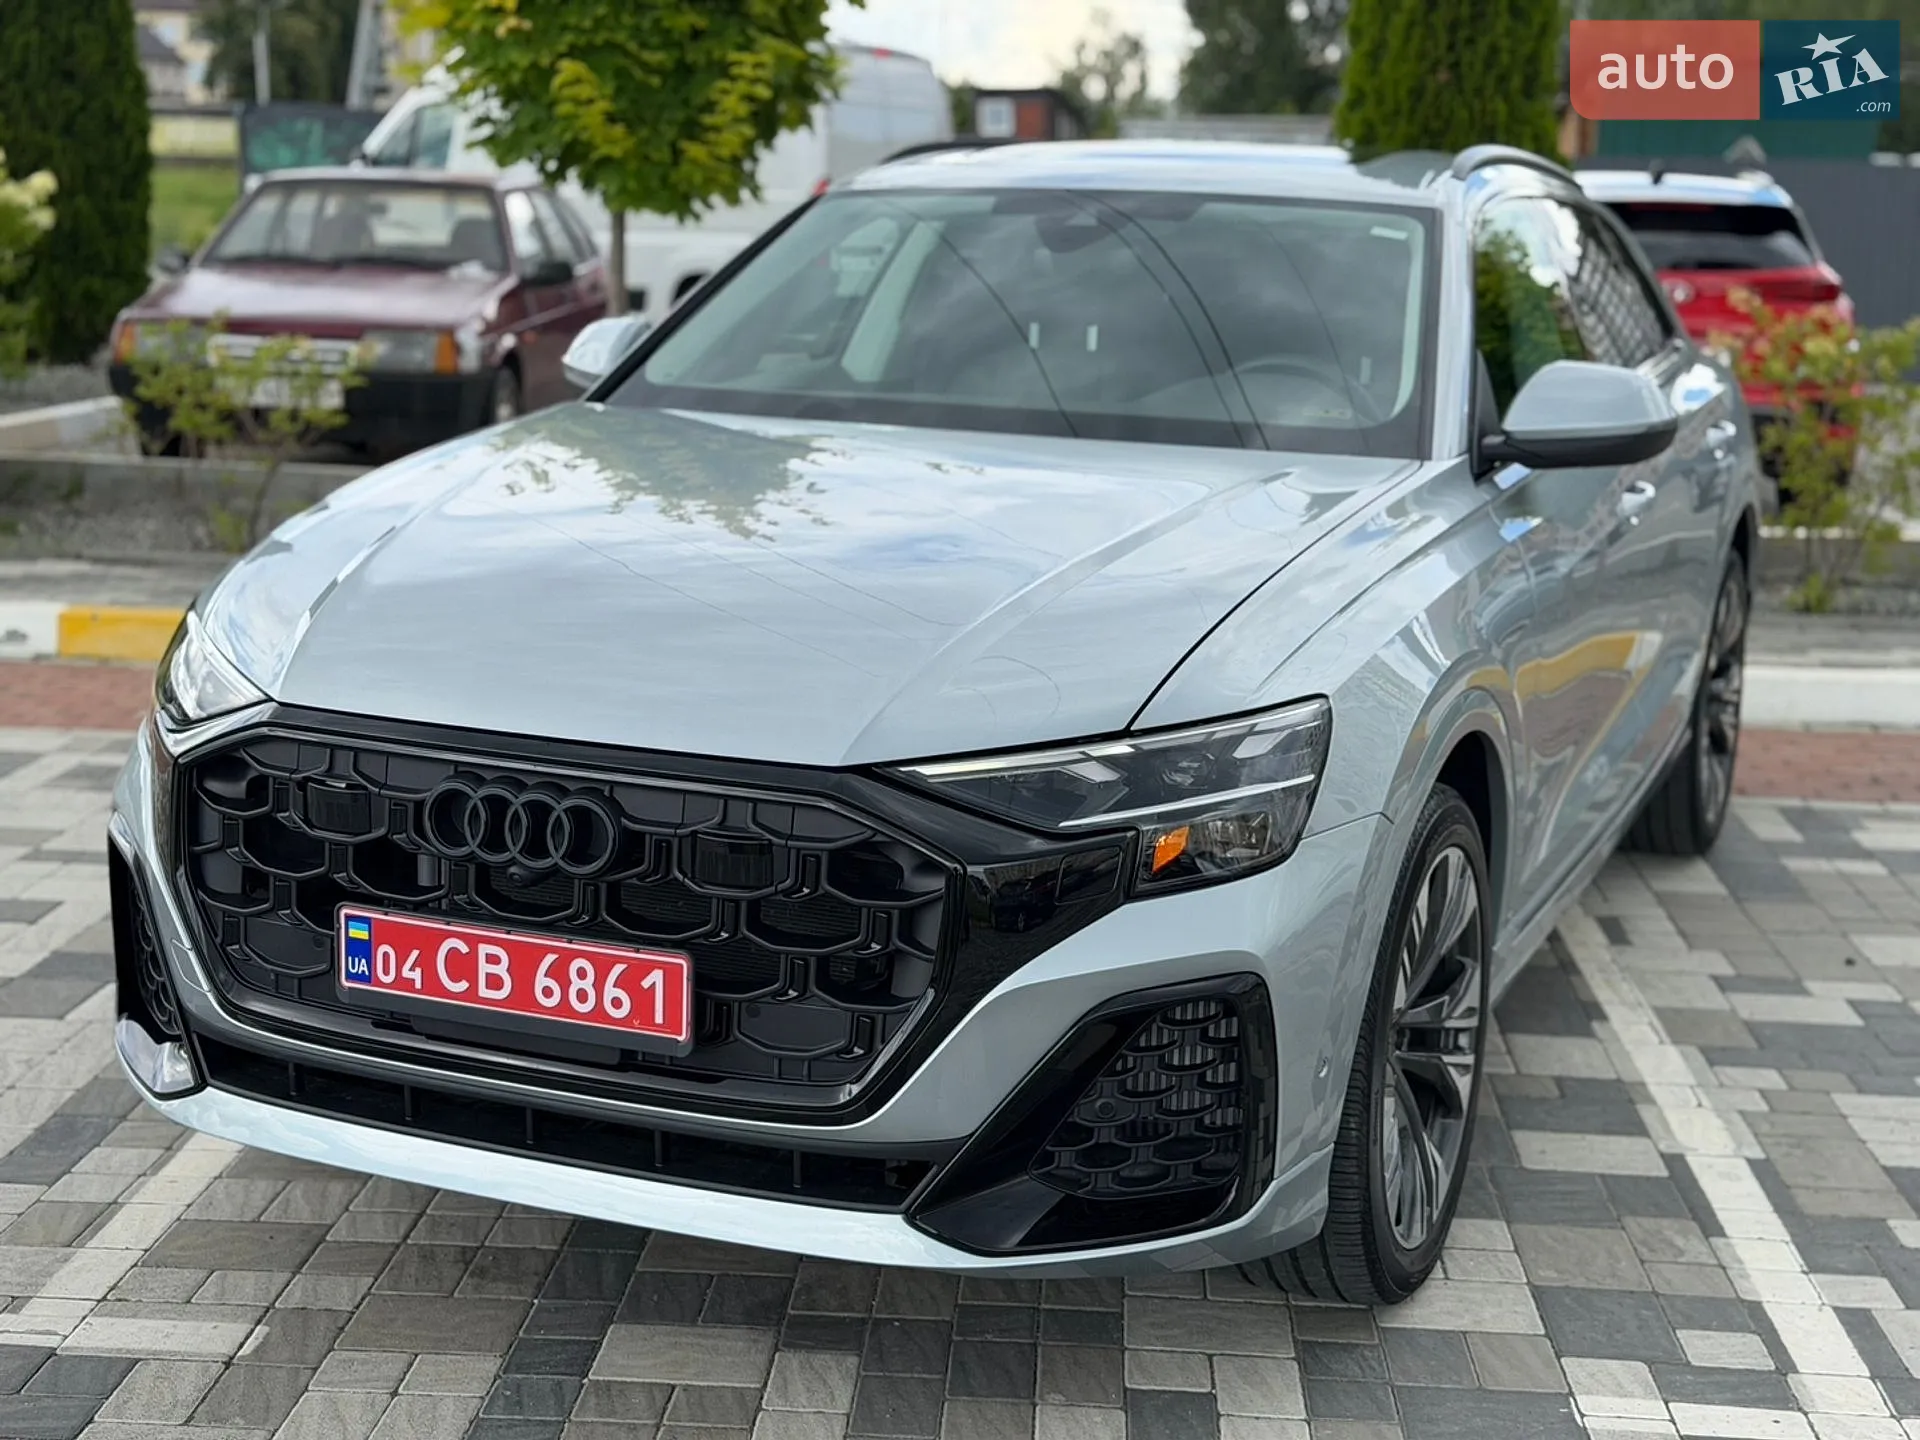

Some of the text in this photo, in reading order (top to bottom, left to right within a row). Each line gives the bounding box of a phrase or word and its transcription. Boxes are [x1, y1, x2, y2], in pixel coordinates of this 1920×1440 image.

[347, 956, 369, 976] UA
[376, 937, 664, 1024] 04 CB 6861
